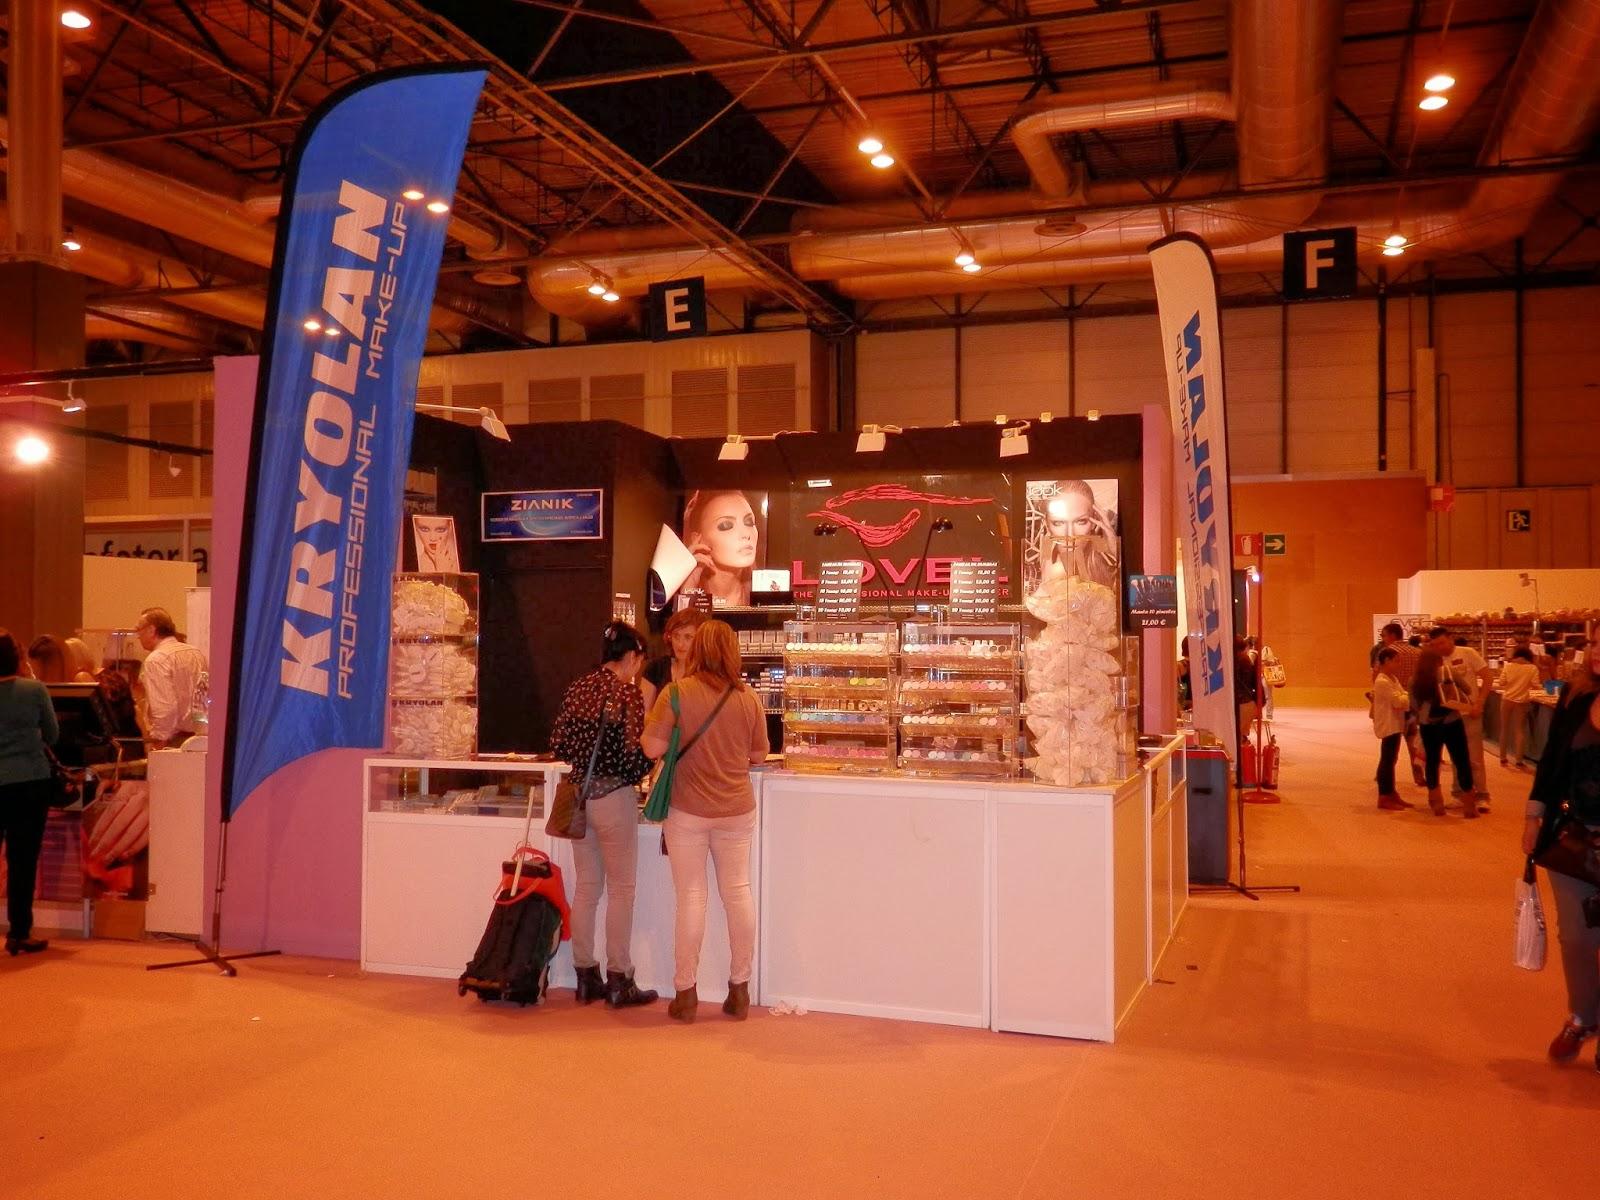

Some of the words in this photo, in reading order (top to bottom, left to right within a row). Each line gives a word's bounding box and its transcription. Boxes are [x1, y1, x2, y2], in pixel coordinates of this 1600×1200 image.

[1306, 240, 1334, 288] F
[665, 287, 690, 331] E
[281, 179, 387, 697] KRYOLAN
[338, 405, 377, 699] PROFESSIONAL
[366, 202, 408, 379] MAKE-UP
[511, 498, 574, 511] ZIANIK
[792, 557, 1008, 585] LVE
[907, 589, 949, 597] MAKE-U
